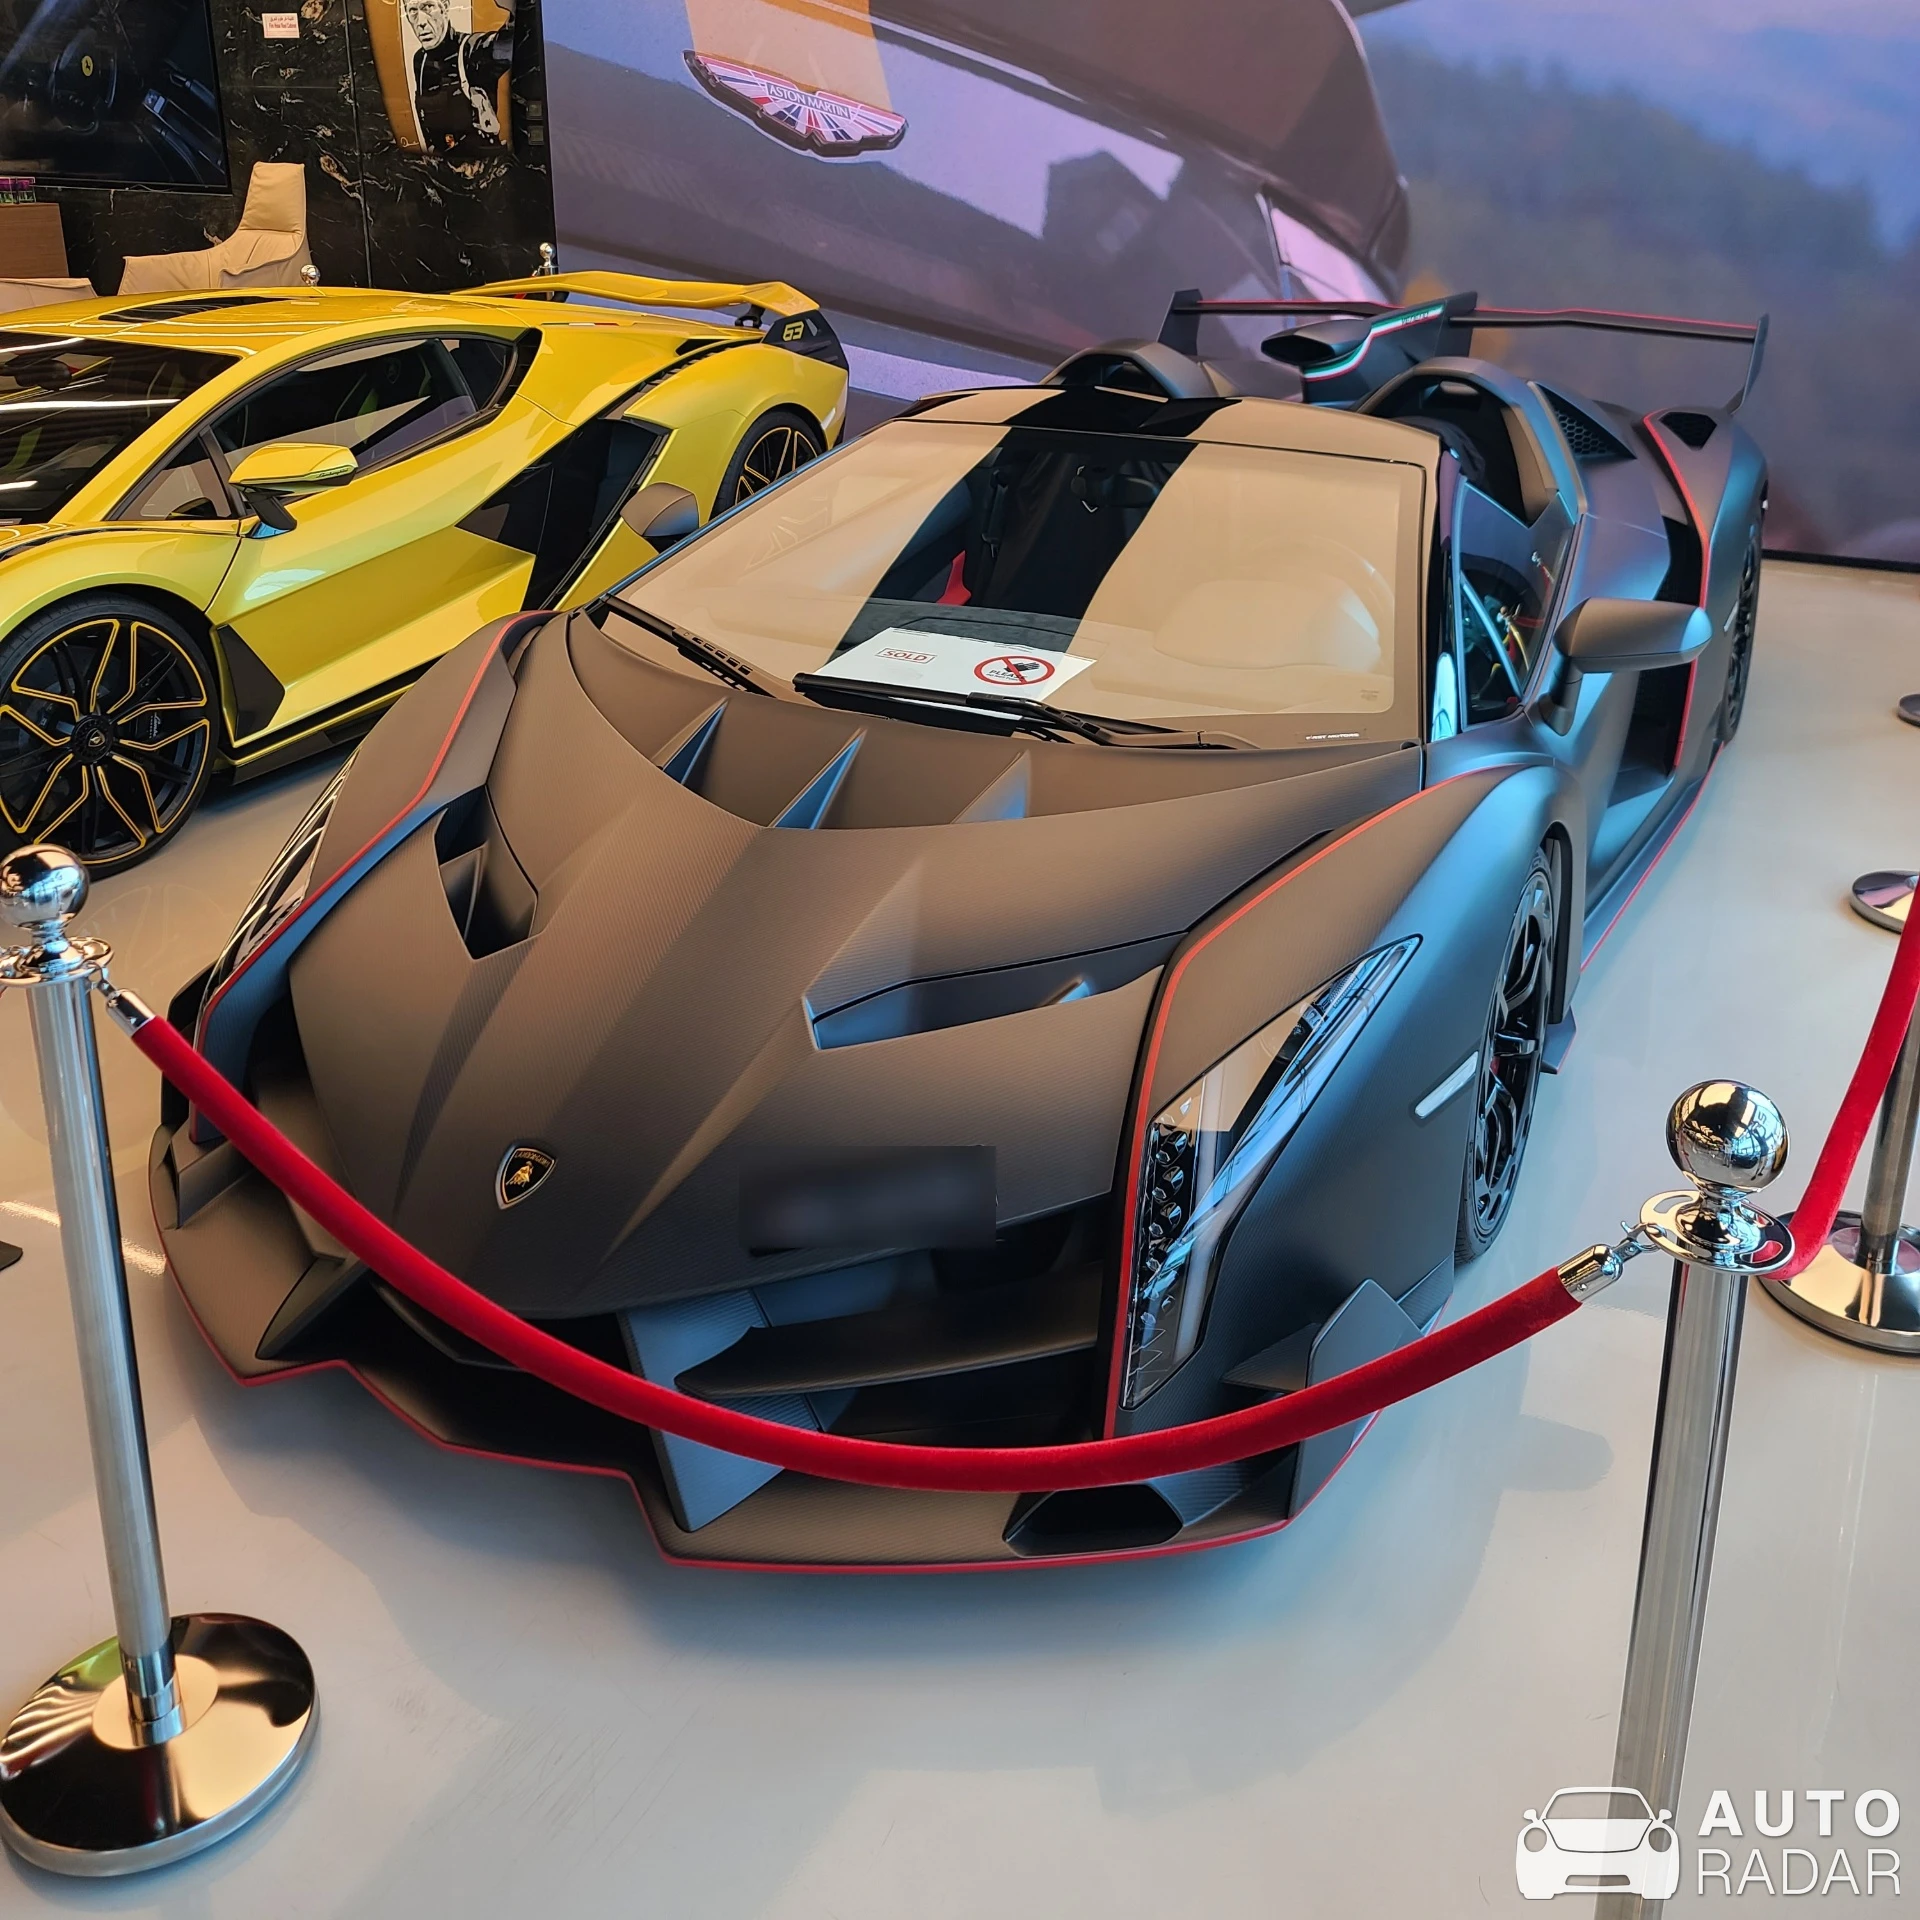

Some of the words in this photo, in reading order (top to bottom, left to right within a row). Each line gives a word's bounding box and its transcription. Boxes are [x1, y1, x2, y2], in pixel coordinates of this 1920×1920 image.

[769, 85, 807, 105] ASTON
[807, 96, 848, 117] MARTIN
[783, 320, 805, 342] 63
[883, 650, 928, 661] SOLD
